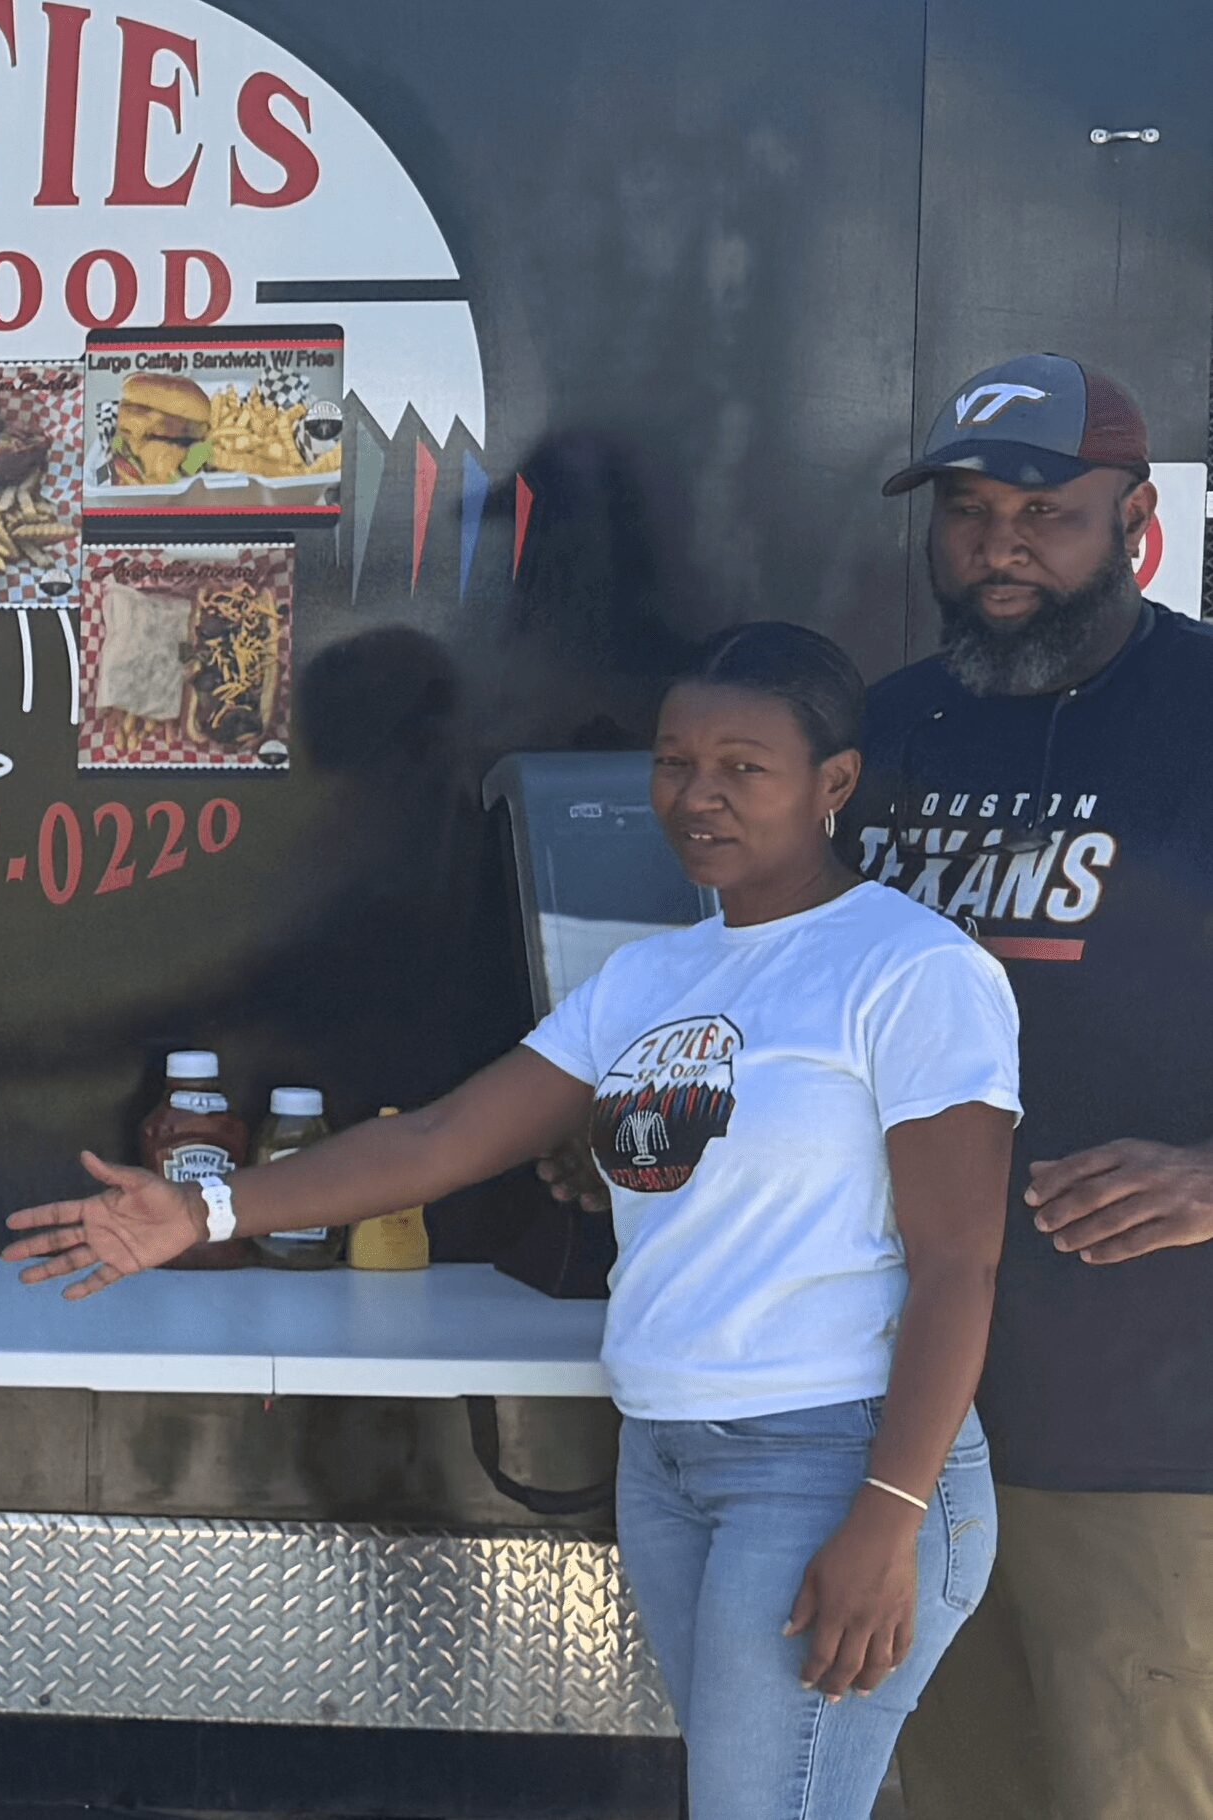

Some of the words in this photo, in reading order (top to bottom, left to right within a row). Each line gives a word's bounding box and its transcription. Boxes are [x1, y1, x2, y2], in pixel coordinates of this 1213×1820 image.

[88, 353, 131, 374] Large
[135, 352, 188, 372] Catfish
[192, 350, 266, 369] Sandwich
[296, 350, 334, 367] Fries
[955, 382, 1048, 430] VT
[890, 792, 1097, 819] OUSTON
[859, 826, 1117, 923] TEXANS
[637, 1037, 659, 1065] 7
